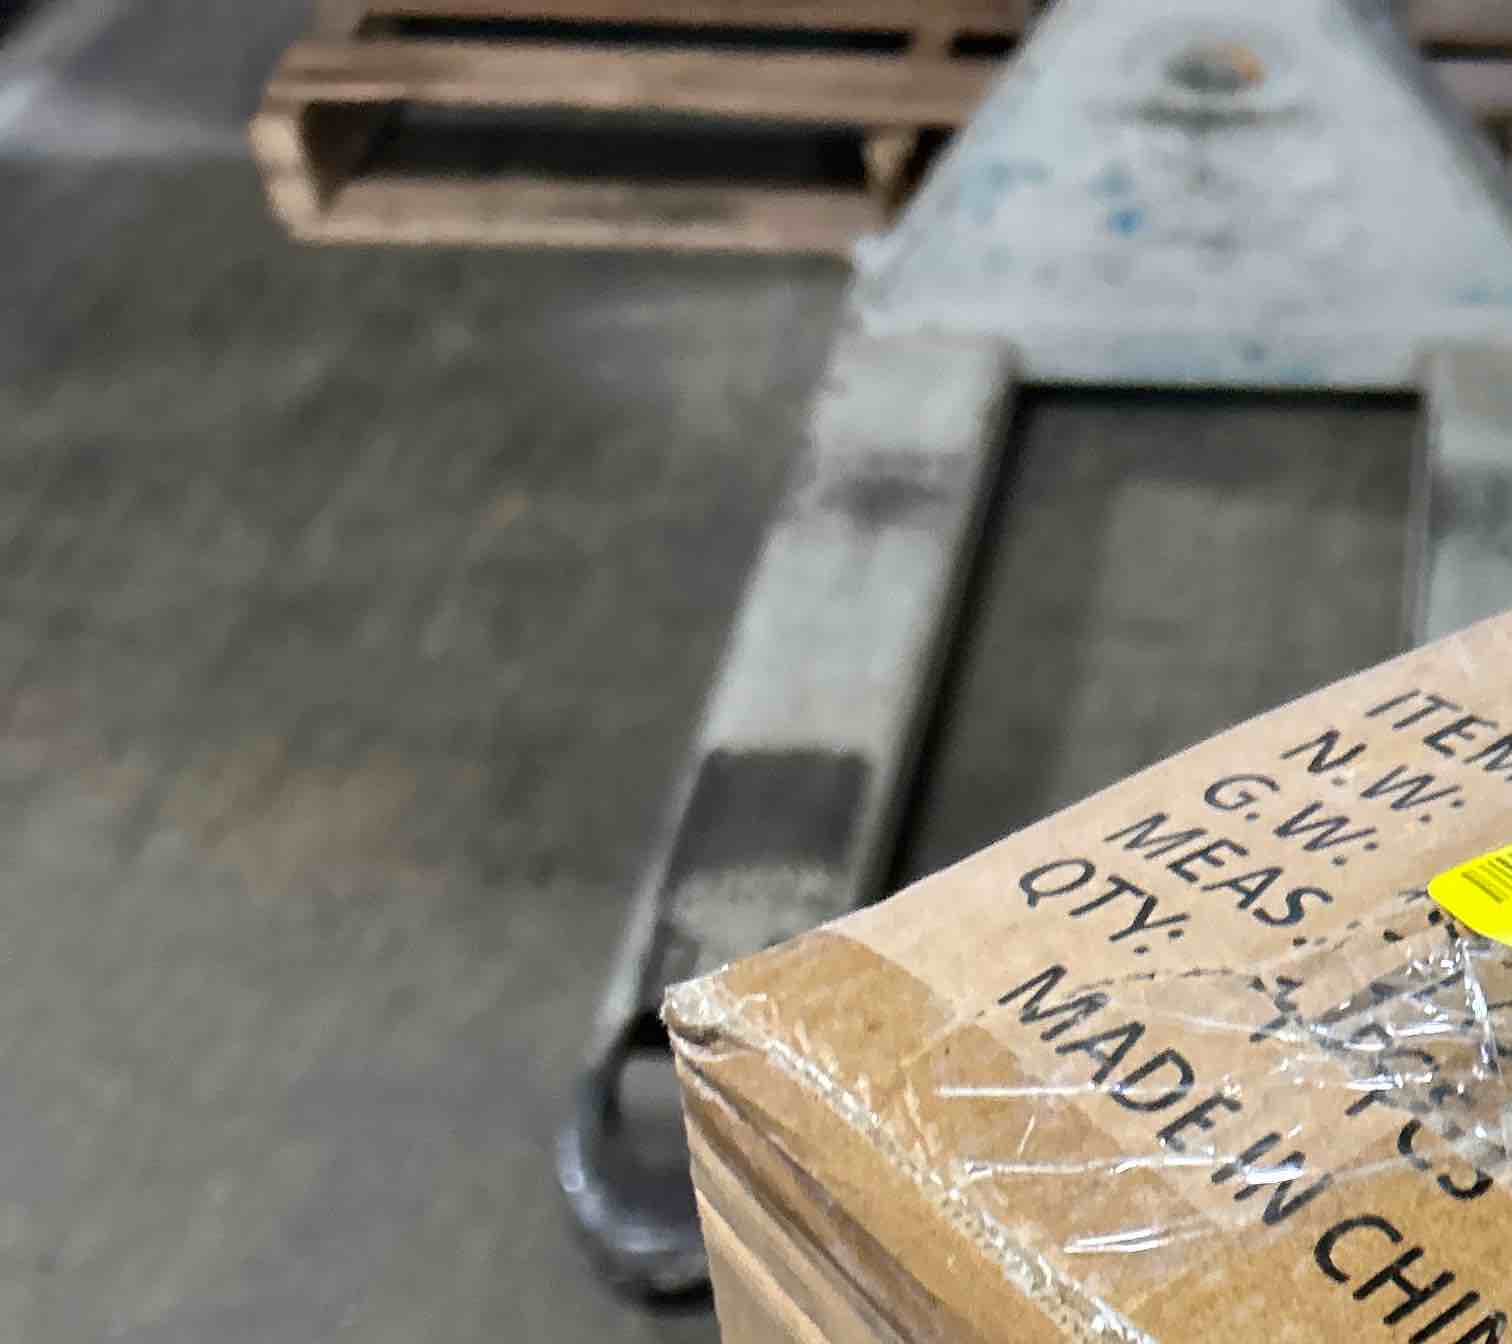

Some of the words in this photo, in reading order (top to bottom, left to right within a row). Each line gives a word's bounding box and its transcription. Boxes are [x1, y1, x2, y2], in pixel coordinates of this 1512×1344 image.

[1202, 773, 1380, 867] G.W:
[1280, 729, 1467, 823] N.W:
[1017, 859, 1191, 954] QTY:
[998, 964, 1243, 1153] MADE
[1211, 1131, 1335, 1227] IN
